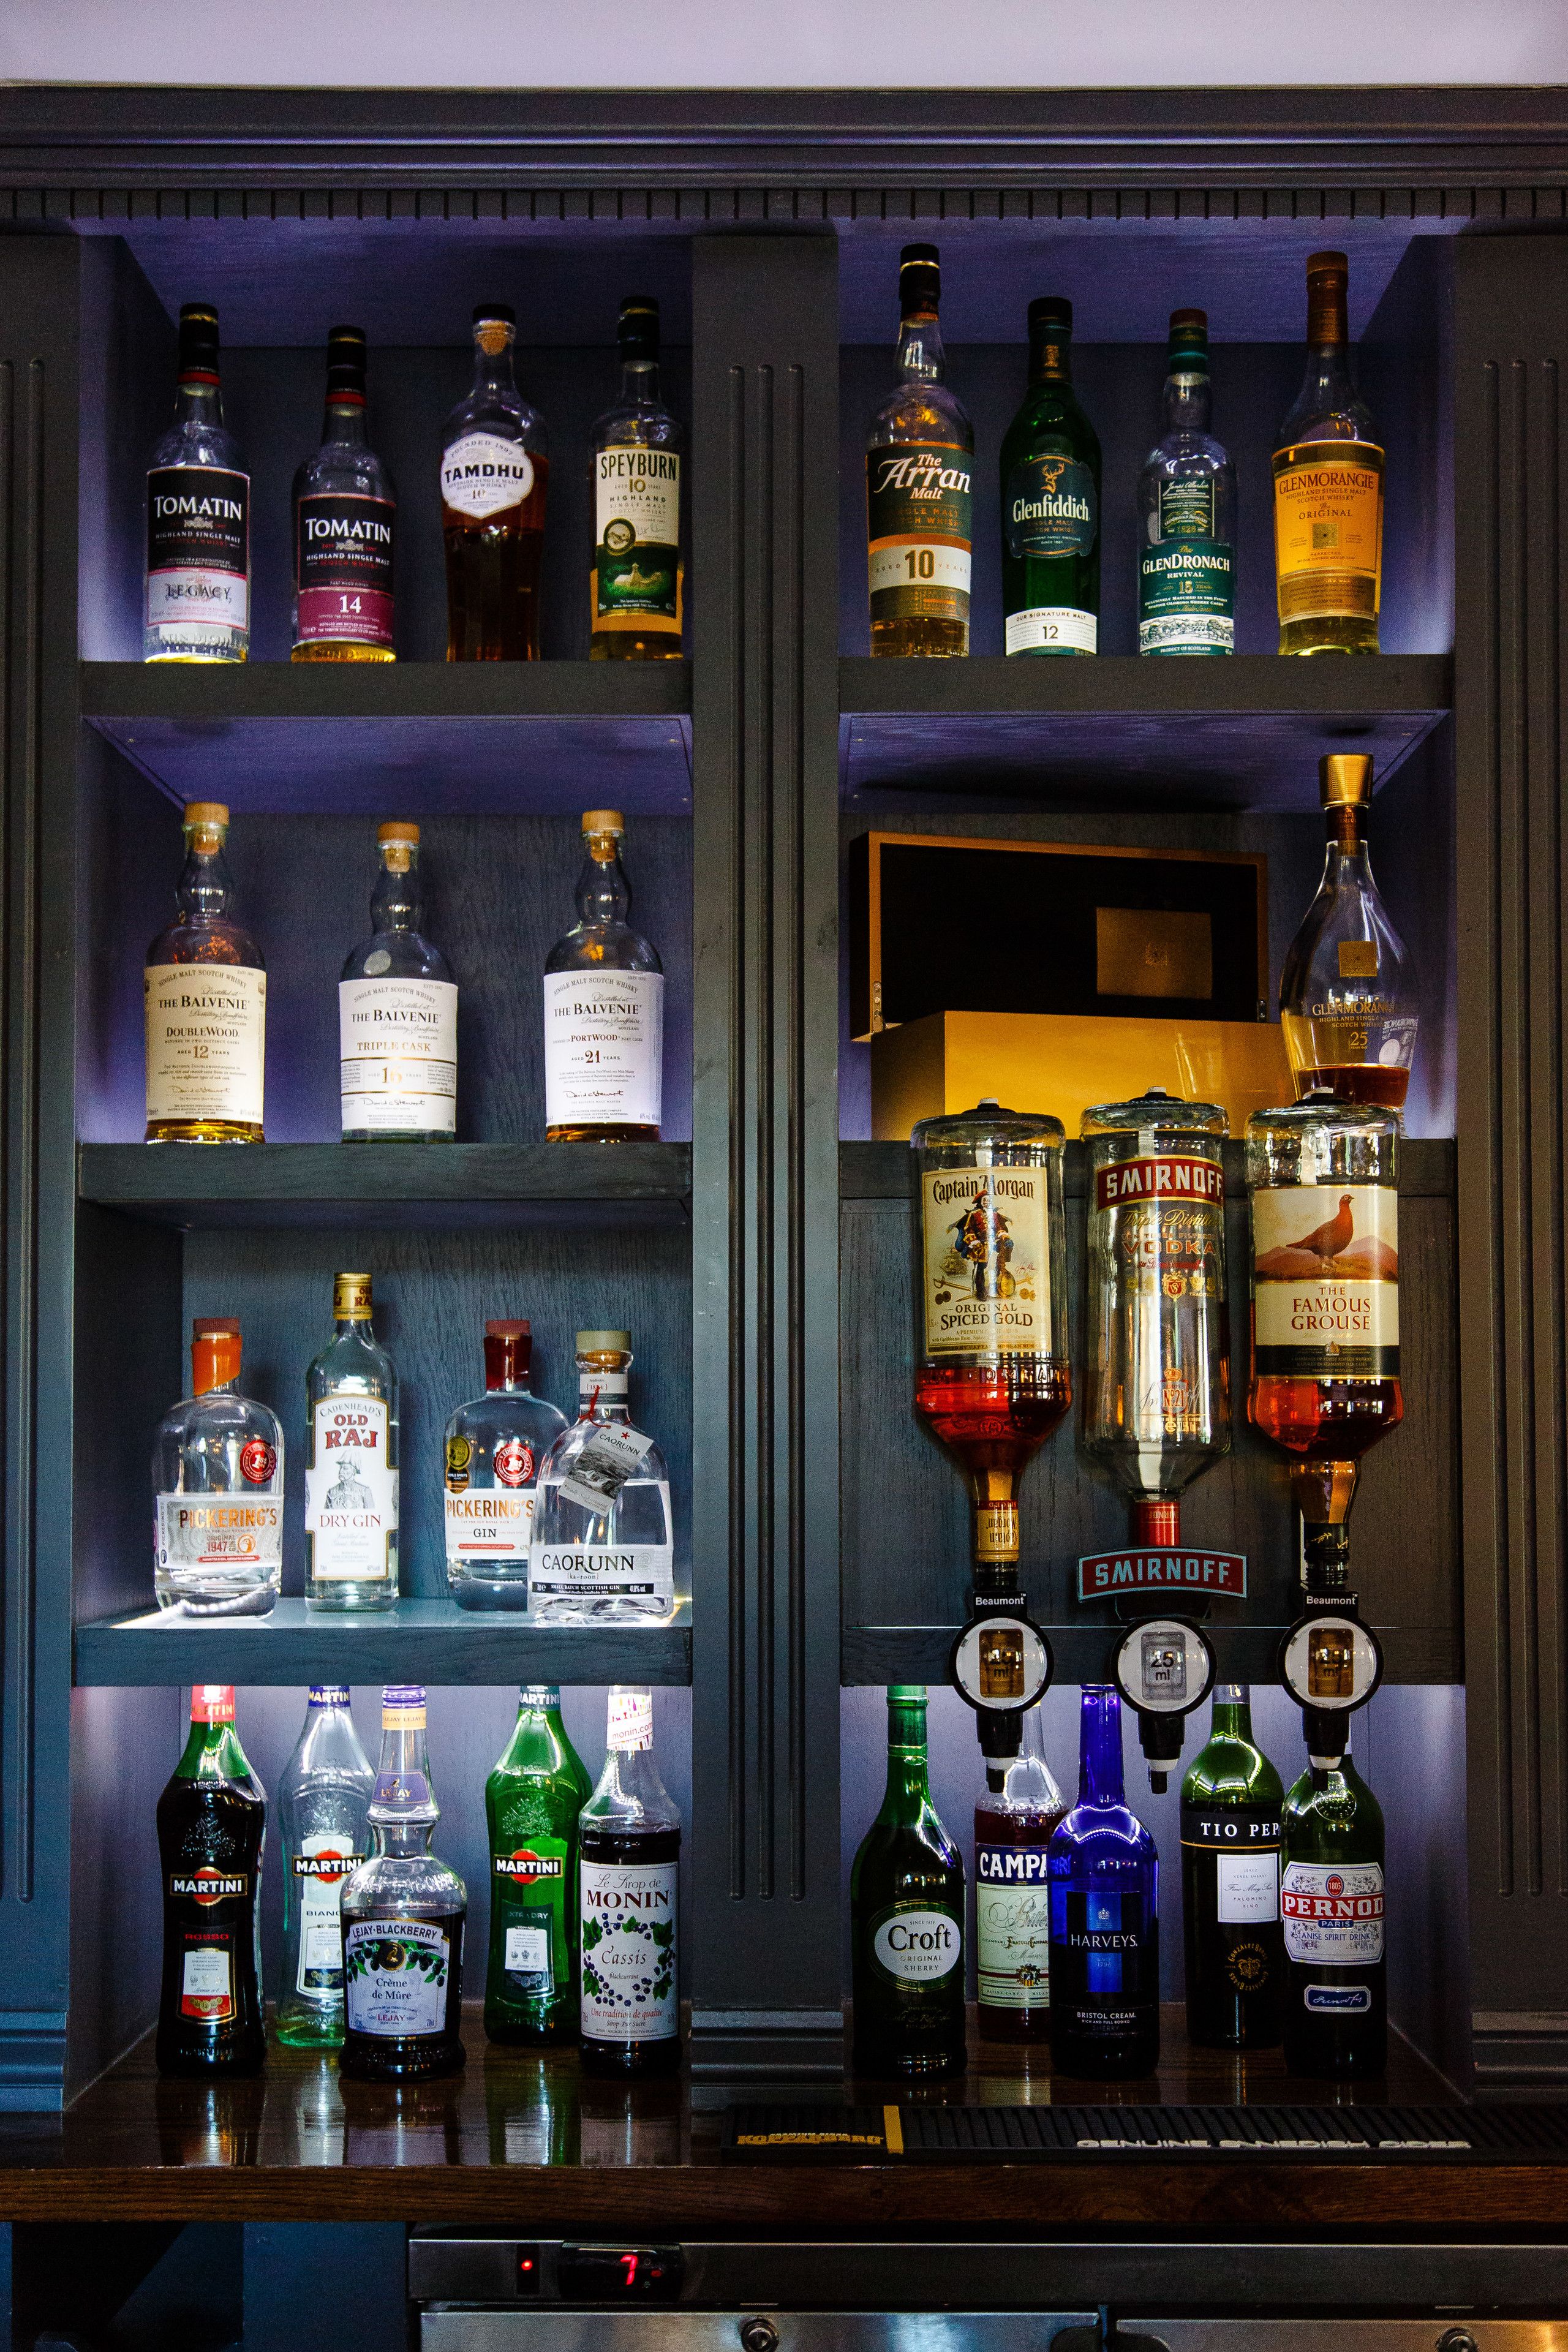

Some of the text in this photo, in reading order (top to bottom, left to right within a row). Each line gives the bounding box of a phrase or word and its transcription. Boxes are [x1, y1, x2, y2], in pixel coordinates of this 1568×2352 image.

[601, 453, 676, 480] SPEYBURN
[918, 454, 942, 466] The
[445, 464, 524, 483] TAMDHU
[873, 457, 971, 494] Arran
[629, 478, 646, 492] 10
[1280, 472, 1374, 494] GLENMORANGIE
[910, 487, 944, 500] Malt
[1286, 489, 1321, 500] HIGHLAND
[154, 496, 242, 521] TOMATIN
[1012, 494, 1089, 522] Glenfiddich
[1298, 510, 1353, 519] ORIGINAL
[156, 530, 193, 539] HIGHLAND
[196, 531, 222, 540] SINGLE
[225, 534, 240, 544] MALT
[306, 518, 391, 544] TOMATIN
[306, 553, 345, 562] HIGHLAND
[375, 557, 390, 566] MALT
[905, 549, 935, 579] 10
[1143, 554, 1230, 575] GLENDRONACH
[167, 584, 231, 600] LEGACY
[339, 595, 361, 614] 14
[1042, 625, 1058, 639] 12
[159, 975, 177, 987] SINGLE
[198, 970, 224, 978] SCOTCH
[226, 974, 247, 988] WHISKY
[553, 982, 570, 996] SINGLE
[616, 980, 639, 993] WHISKY
[158, 995, 247, 1010] THE BALVENIE
[353, 990, 371, 1002] SINGLE
[416, 990, 437, 1003] WHISKY
[352, 1009, 439, 1024] THE BALVENIE
[554, 1003, 639, 1017] THE BALVENIE
[167, 1027, 239, 1037] DOUBLEWOOD
[571, 1034, 618, 1042] PORTWOOD
[1350, 1031, 1368, 1046] 25
[193, 1045, 209, 1058] 12
[357, 1042, 431, 1052] TRIPLE CASK
[585, 1050, 600, 1063] 21
[382, 1066, 402, 1084] 16
[1107, 1165, 1223, 1198] SMIRNOFF
[932, 1175, 1034, 1205] Captain Morgan
[1120, 1209, 1163, 1231] Triple
[1122, 1240, 1215, 1254] VODKA
[955, 1303, 1017, 1313] ORIGINAL
[1293, 1298, 1371, 1313] FAMOUS
[940, 1313, 1033, 1330] SPICED GOLD
[1291, 1315, 1371, 1330] GROUSE
[320, 1403, 383, 1418] CADENHEAD'S
[334, 1414, 368, 1427] OLD
[325, 1428, 378, 1450] RAJ
[599, 1434, 640, 1455] CAORUNN
[447, 1499, 533, 1519] PICKERING'S
[179, 1508, 277, 1528] PICKERING'S
[320, 1515, 381, 1528] DRY GIN
[473, 1528, 497, 1538] GIN
[207, 1540, 227, 1552] 1947
[542, 1555, 635, 1574] CAORUNN
[1095, 1558, 1230, 1586] SMIRNOFF
[975, 1597, 1024, 1606] Beaumont
[1306, 1596, 1355, 1605] Beaumont
[1151, 1650, 1175, 1668] 25
[993, 1666, 1009, 1678] ml
[1155, 1669, 1170, 1681] ml
[382, 1789, 412, 1797] LEJAY
[1201, 1822, 1280, 1837] TIO PEP
[296, 1859, 361, 1872] MARTINI
[496, 1860, 559, 1874] MARTINI
[174, 1880, 242, 1893] MARTINI
[594, 1873, 661, 1893] Le Sirop de
[1329, 1882, 1341, 1890] 1805
[587, 1890, 668, 1909] MONIN
[1284, 1894, 1383, 1917] PERNOD
[888, 1924, 952, 1952] Croft
[1071, 1934, 1137, 1948] HARVEYS
[1302, 1932, 1322, 1940] ANISE
[1325, 1932, 1346, 1941] SPIRIT
[601, 1945, 647, 1966] Cassis
[376, 1977, 407, 1988] Crème
[372, 1990, 412, 2000] de Mûre
[591, 2008, 641, 2019] Une tradition de
[620, 2254, 638, 2285] 7
